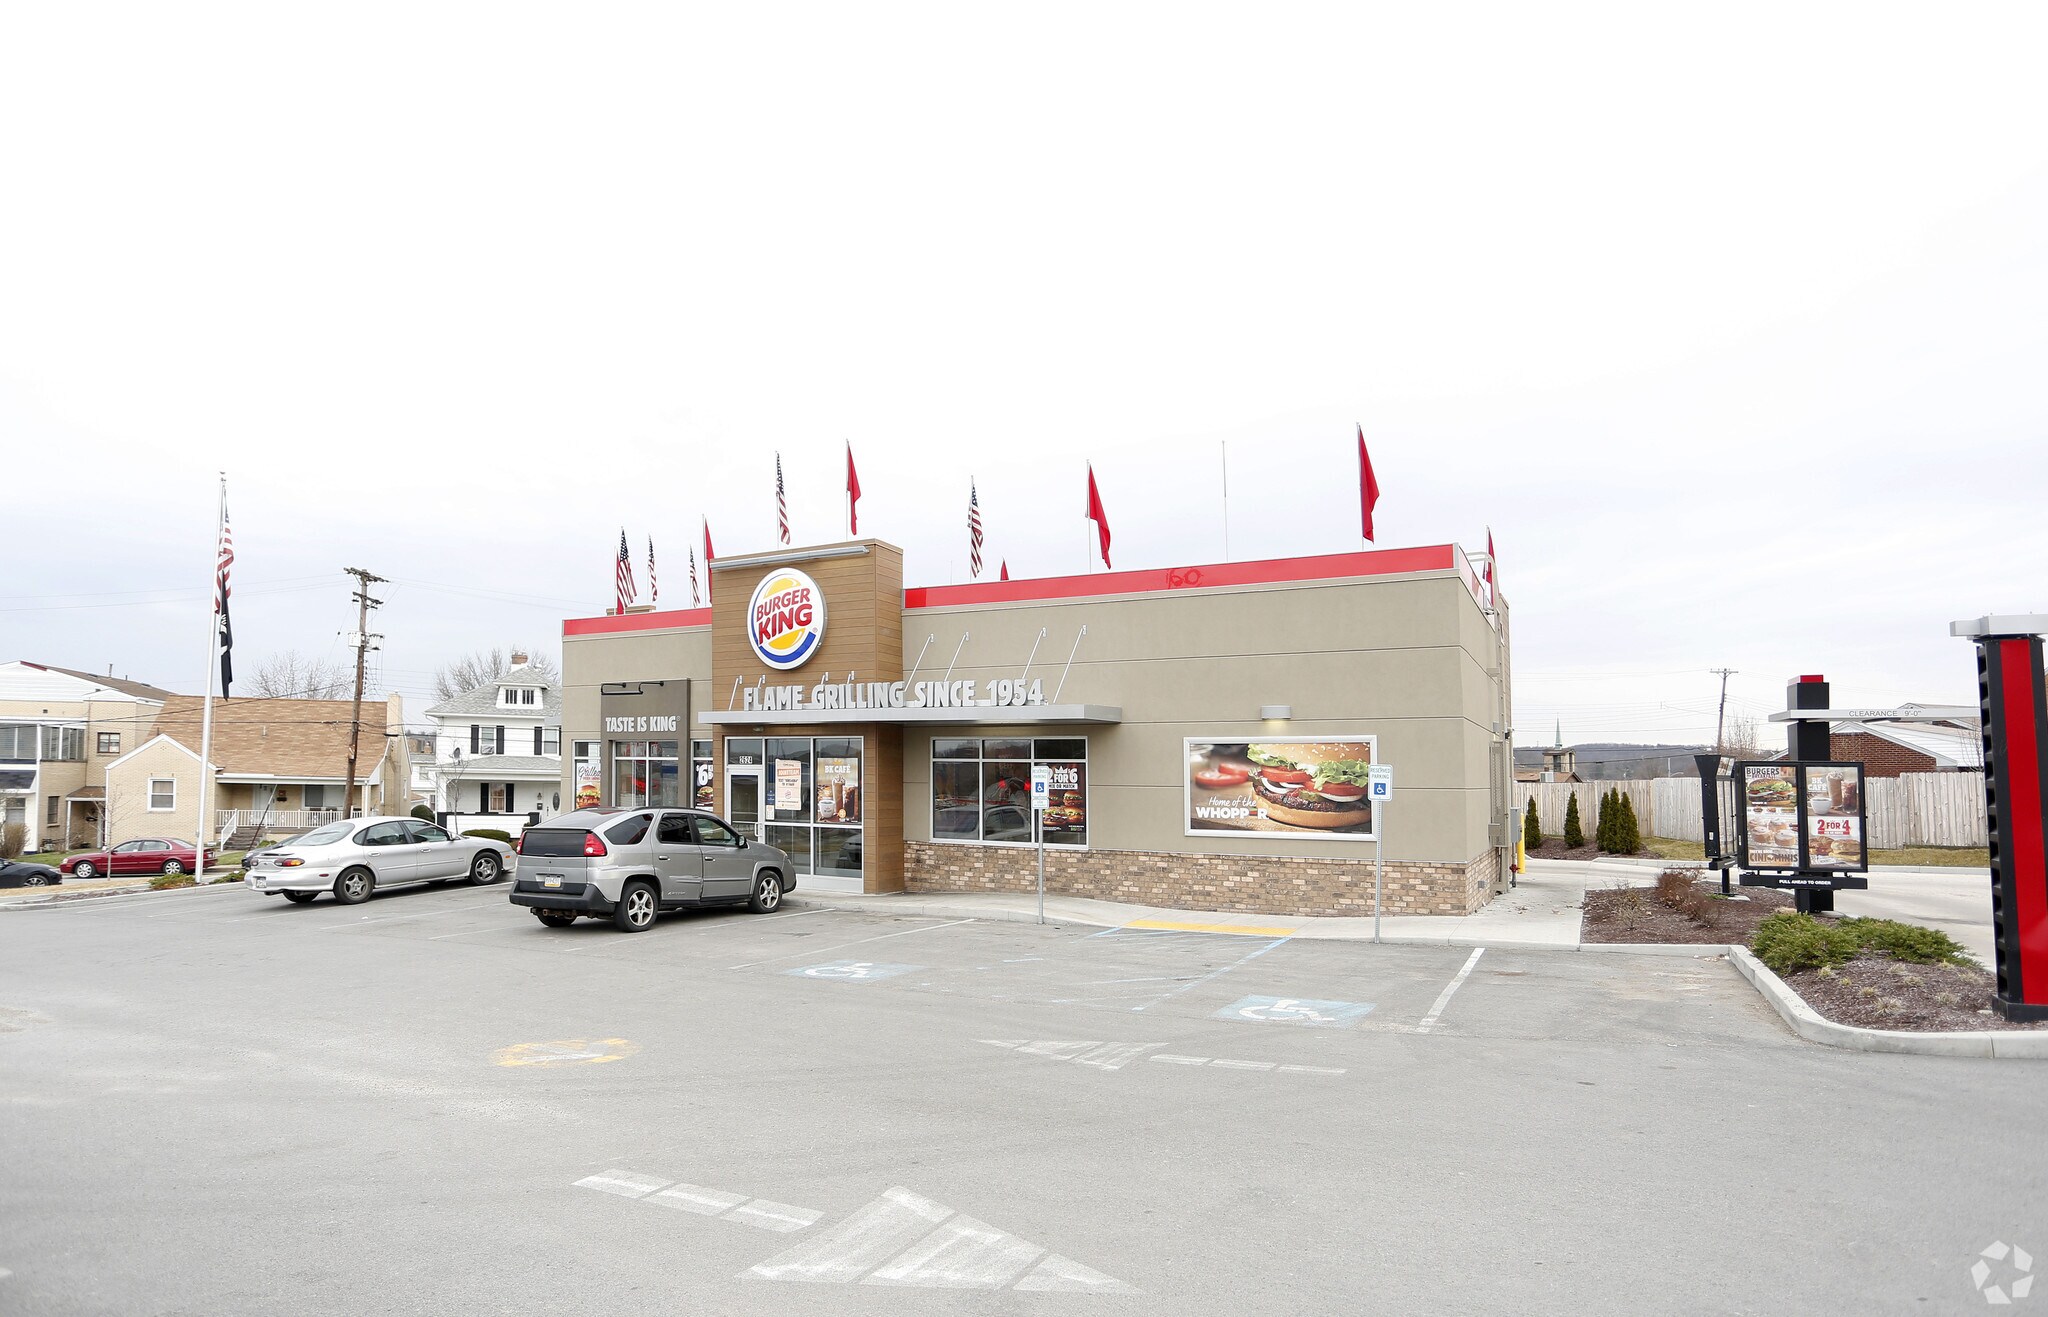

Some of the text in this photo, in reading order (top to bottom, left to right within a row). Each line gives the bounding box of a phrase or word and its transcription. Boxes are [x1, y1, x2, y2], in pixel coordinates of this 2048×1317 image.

[756, 587, 811, 622] BURGER
[758, 603, 813, 645] KING
[743, 678, 1044, 711] FLAME GRILLING SINCE 1954
[605, 716, 635, 733] TASTE
[636, 716, 648, 732] IS
[824, 763, 851, 774] BK CAFÉ
[1746, 767, 1780, 776] BURGERS
[1053, 773, 1069, 783] FOR
[1811, 776, 1823, 784] BK
[1208, 795, 1257, 808] Home of the
[1817, 819, 1826, 831] 2
[1826, 821, 1841, 830] FOR
